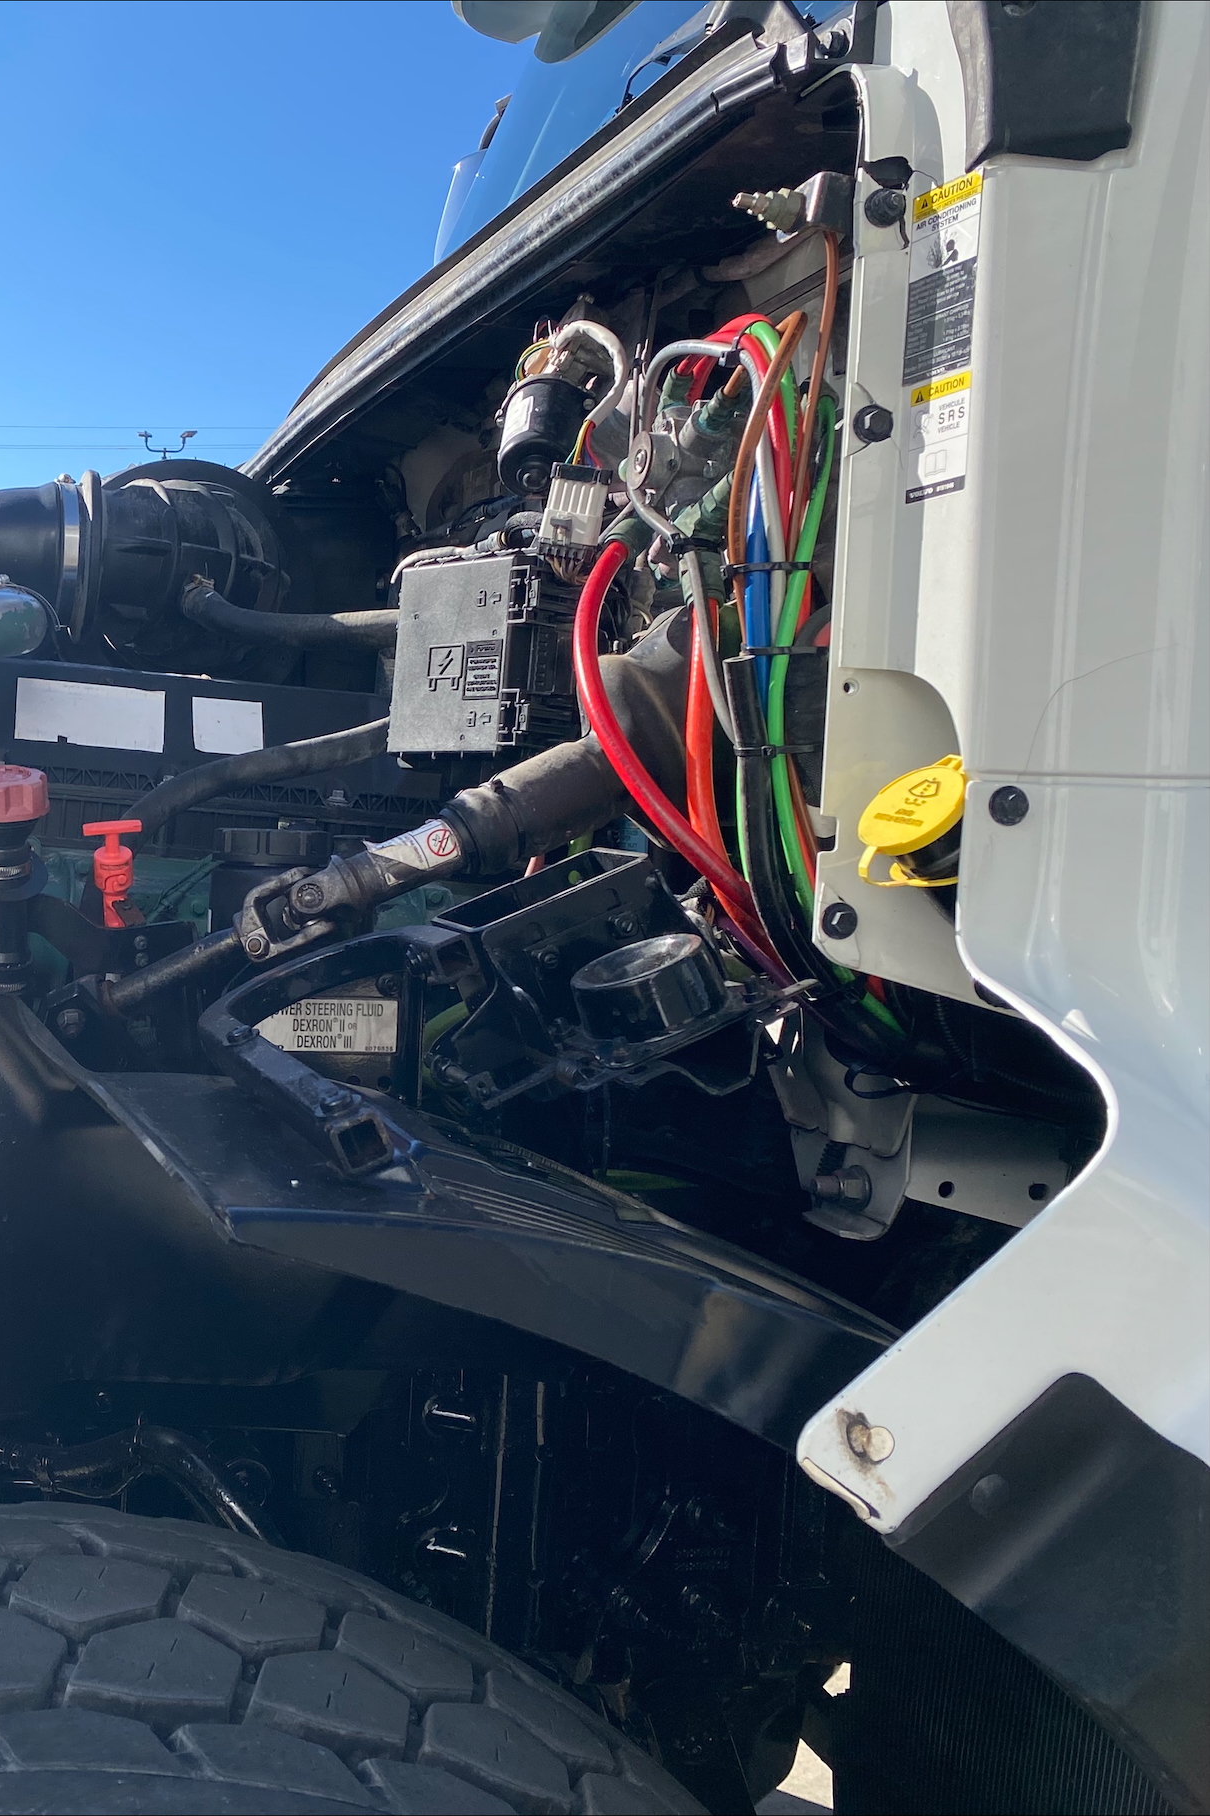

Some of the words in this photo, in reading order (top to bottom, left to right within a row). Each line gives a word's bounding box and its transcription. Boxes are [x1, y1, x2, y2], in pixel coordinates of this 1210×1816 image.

[931, 176, 973, 204] CAUTION
[916, 221, 927, 231] AIR
[927, 197, 977, 225] CONDITIONING
[931, 214, 959, 231] SYSTEM
[928, 377, 965, 397] CAUTION
[938, 397, 965, 411] VEHICULE
[937, 421, 960, 434] VEHICLE
[909, 486, 933, 498] VOLVO
[305, 1003, 353, 1017] STEERING
[356, 1004, 384, 1017] FLUID
[339, 1020, 345, 1032] II
[347, 1022, 358, 1031] OR
[343, 1036, 352, 1048] III
